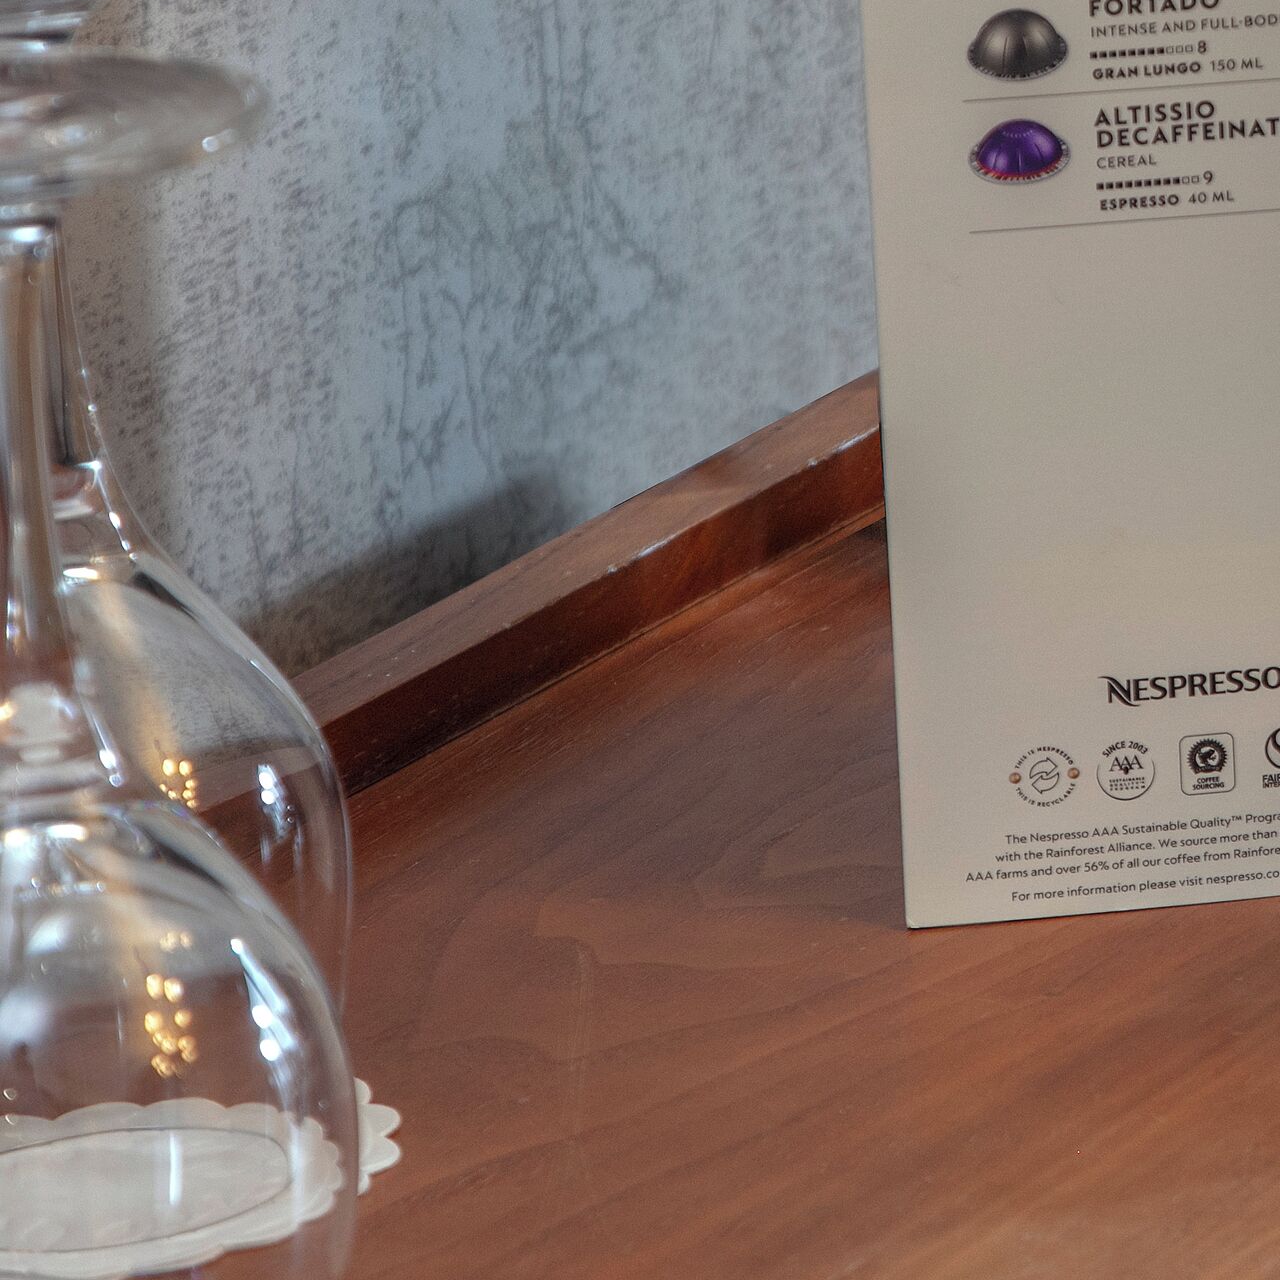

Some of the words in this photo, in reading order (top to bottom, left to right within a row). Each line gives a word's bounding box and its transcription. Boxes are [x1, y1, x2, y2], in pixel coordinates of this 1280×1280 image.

[1090, 21, 1157, 38] INTENSE
[1162, 19, 1197, 34] AND
[1197, 41, 1207, 54] 8
[1092, 66, 1139, 81] GRAN
[1143, 61, 1201, 77] LUNGO
[1210, 58, 1236, 72] 150
[1241, 57, 1263, 70] ML
[1094, 101, 1215, 127] ALTISSIO
[1096, 154, 1157, 169] CEREAL
[1203, 171, 1213, 185] 9
[1100, 194, 1179, 211] ESPRESSO
[1188, 191, 1207, 205] 40
[1212, 190, 1234, 202] ML
[1102, 740, 1126, 758] SINCE
[1128, 741, 1148, 755] 2003
[1109, 755, 1143, 772] AAA
[1192, 782, 1224, 790] SOURCING
[1196, 776, 1219, 784] COFFEE
[1005, 834, 1027, 845] The
[1030, 830, 1089, 843] Nespresso
[1092, 826, 1119, 837] AAA
[1122, 821, 1187, 835] Sustainable
[995, 852, 1021, 863] with
[1024, 850, 1043, 861] the
[1046, 845, 1105, 858] Rainforest
[1107, 841, 1155, 853] Alliance.
[1158, 839, 1178, 849] We
[1180, 836, 1217, 847] source
[1219, 833, 1249, 843] more
[1252, 829, 1278, 841] than
[965, 871, 993, 882] AAA
[996, 867, 1028, 879] farms
[1030, 865, 1052, 877] and
[1055, 865, 1080, 875] over
[1084, 861, 1109, 873] 56%
[1112, 859, 1124, 870] of
[1127, 857, 1140, 869] all
[1142, 858, 1161, 868] our
[1164, 853, 1200, 866] coffee
[1203, 849, 1230, 861] from
[1011, 891, 1031, 902] For
[1033, 889, 1064, 899] more
[1067, 883, 1136, 897] information
[1139, 879, 1176, 893] please
[1179, 876, 1203, 887] visit
